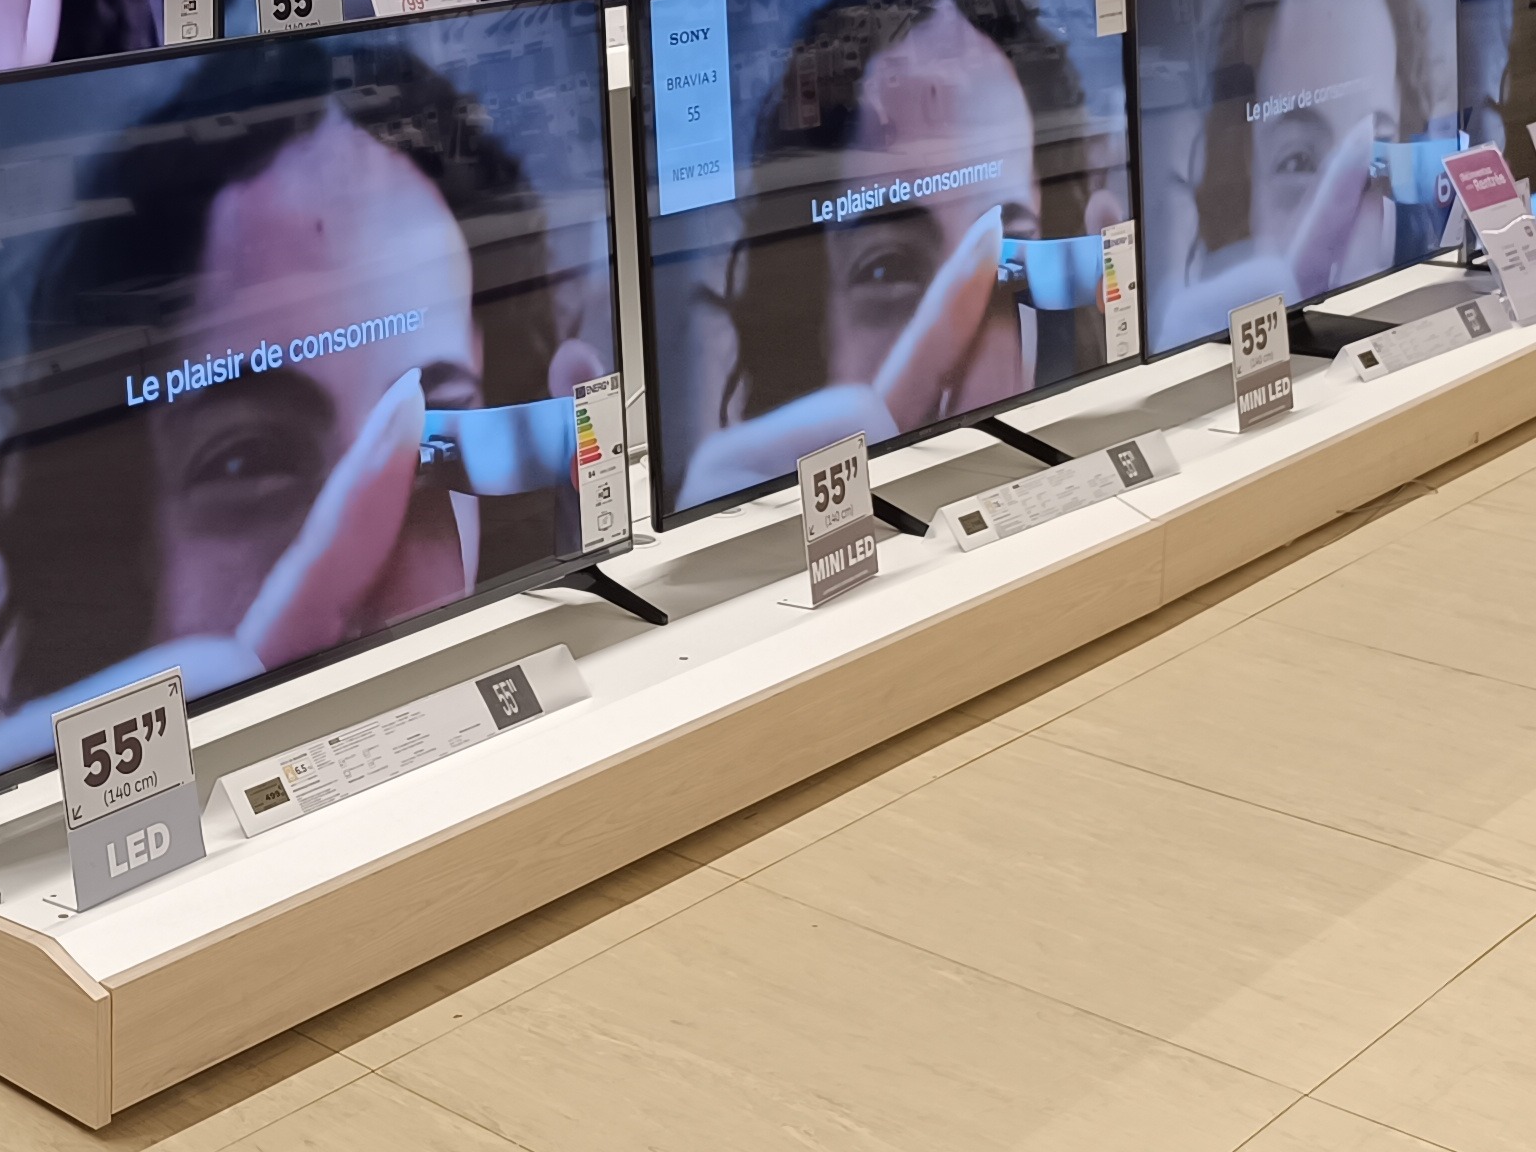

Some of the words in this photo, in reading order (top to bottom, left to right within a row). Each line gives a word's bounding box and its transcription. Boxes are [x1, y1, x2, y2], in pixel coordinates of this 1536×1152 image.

[669, 28, 710, 45] SONY
[667, 72, 709, 91] BRAVIA
[711, 70, 717, 83] 3
[687, 105, 700, 122] 55
[1246, 102, 1261, 121] Le
[1263, 91, 1296, 122] plaisir
[1298, 88, 1312, 108] de
[672, 165, 695, 182] NEW
[697, 160, 720, 177] 2025
[811, 199, 833, 222] Le
[837, 184, 886, 222] plaisir
[889, 178, 910, 203] de
[913, 159, 1004, 197] consommer
[126, 375, 160, 406] Le
[167, 349, 244, 402] plaisir
[250, 340, 283, 372] de
[289, 306, 428, 362] consommer
[1239, 386, 1266, 414] MINI
[1268, 377, 1290, 402] LED
[812, 548, 845, 584] MINI
[848, 535, 875, 566] LED
[294, 764, 307, 775] 6.5
[103, 782, 131, 807] (140
[134, 770, 158, 792] cm)
[107, 822, 170, 878] LED
